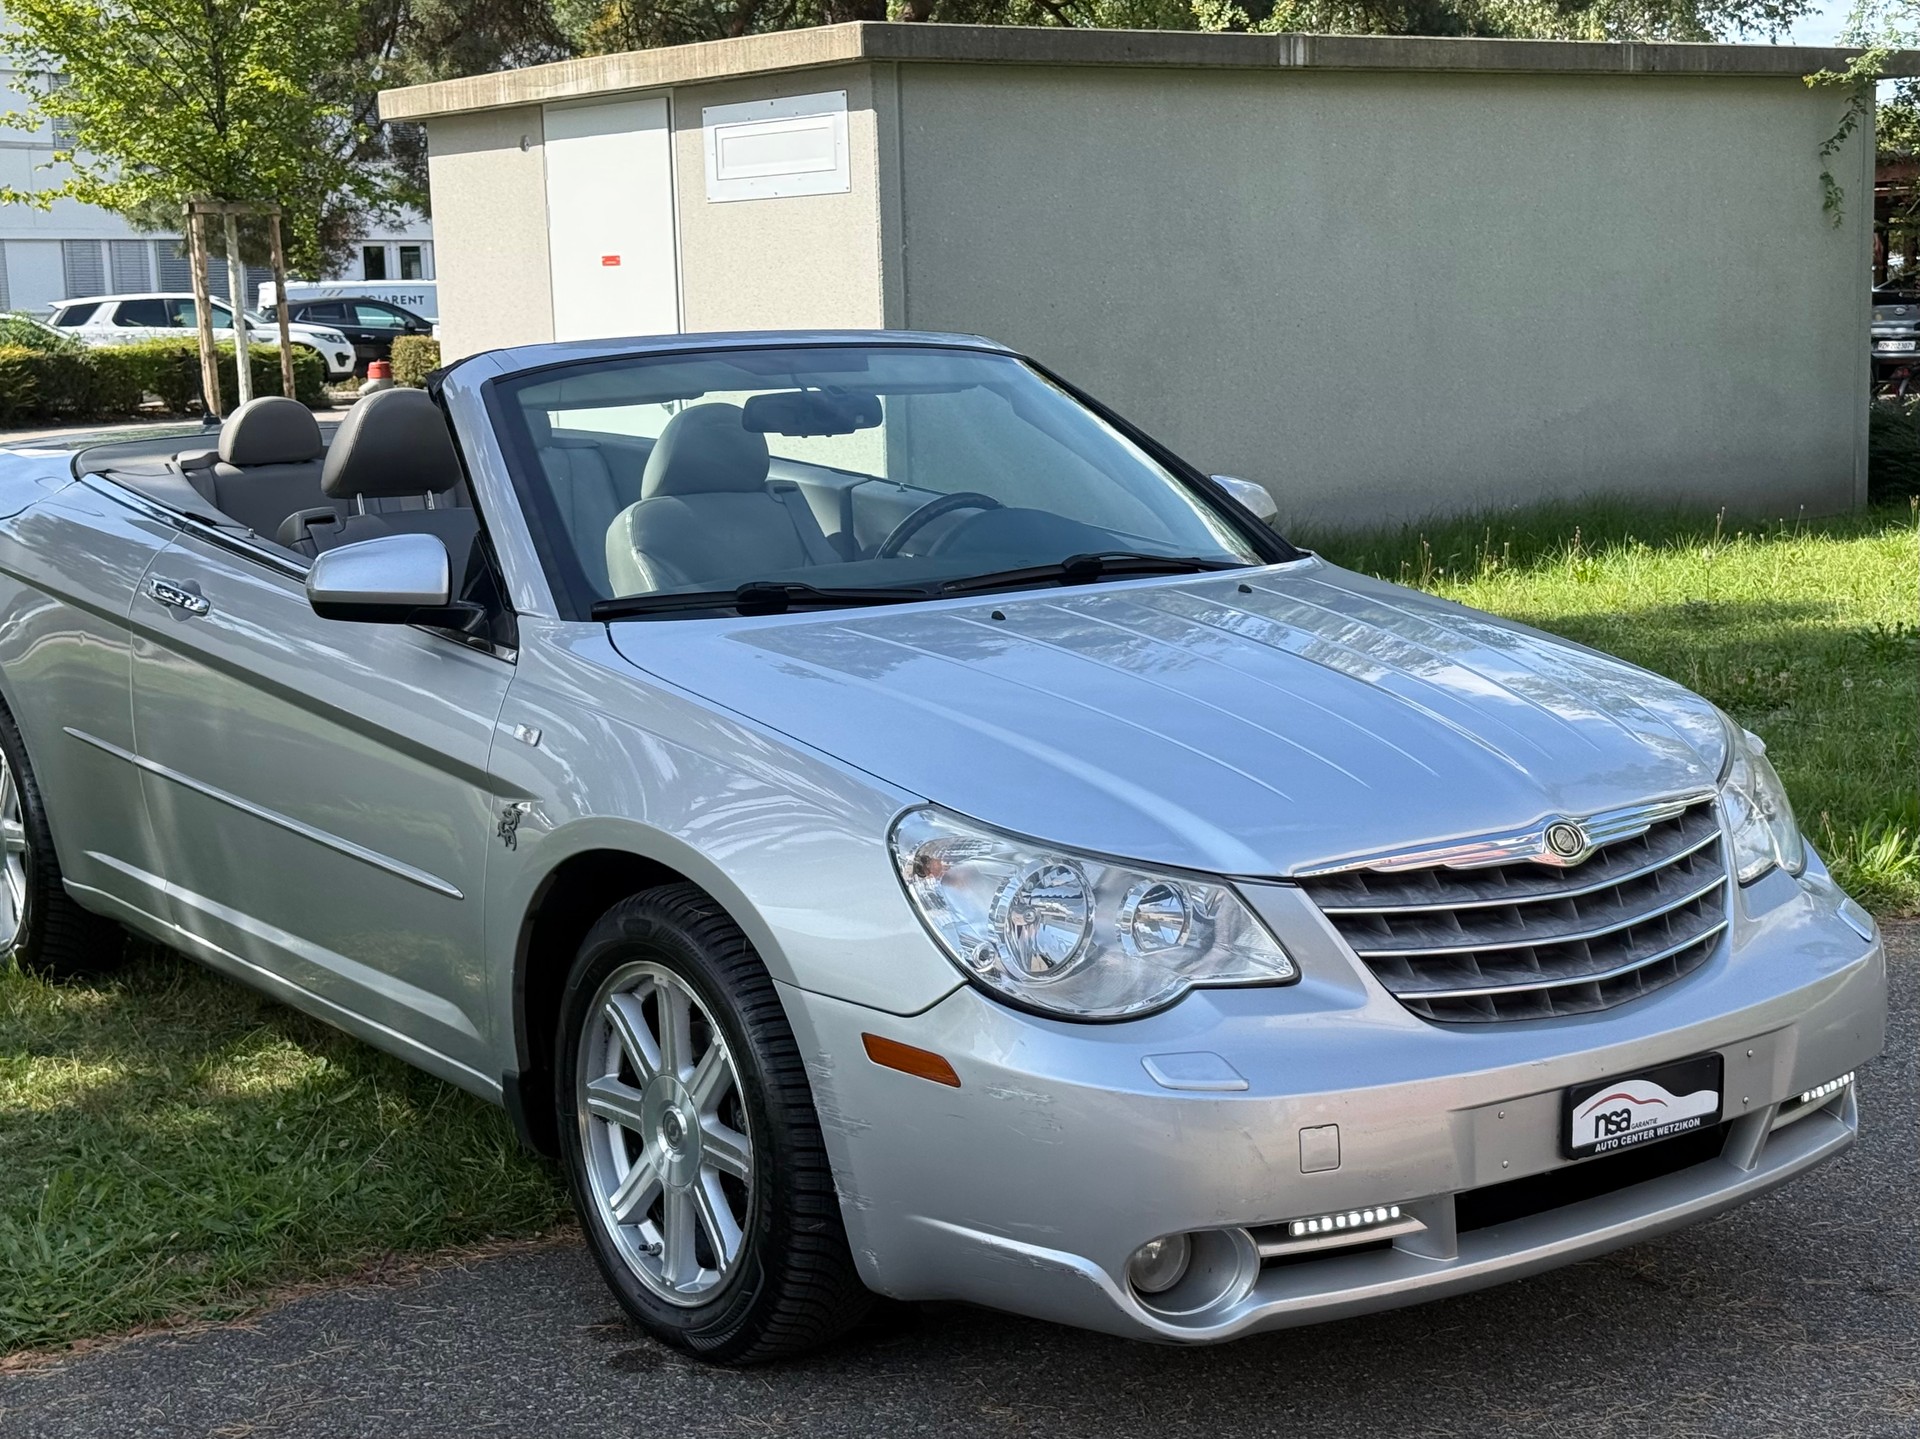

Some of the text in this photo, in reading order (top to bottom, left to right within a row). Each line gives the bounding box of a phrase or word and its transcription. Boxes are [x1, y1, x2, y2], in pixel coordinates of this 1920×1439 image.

[1595, 1108, 1631, 1138] nsa
[1595, 1118, 1700, 1152] AUTO CENTER WETZIKON
[1631, 1118, 1658, 1129] GARANTIE
